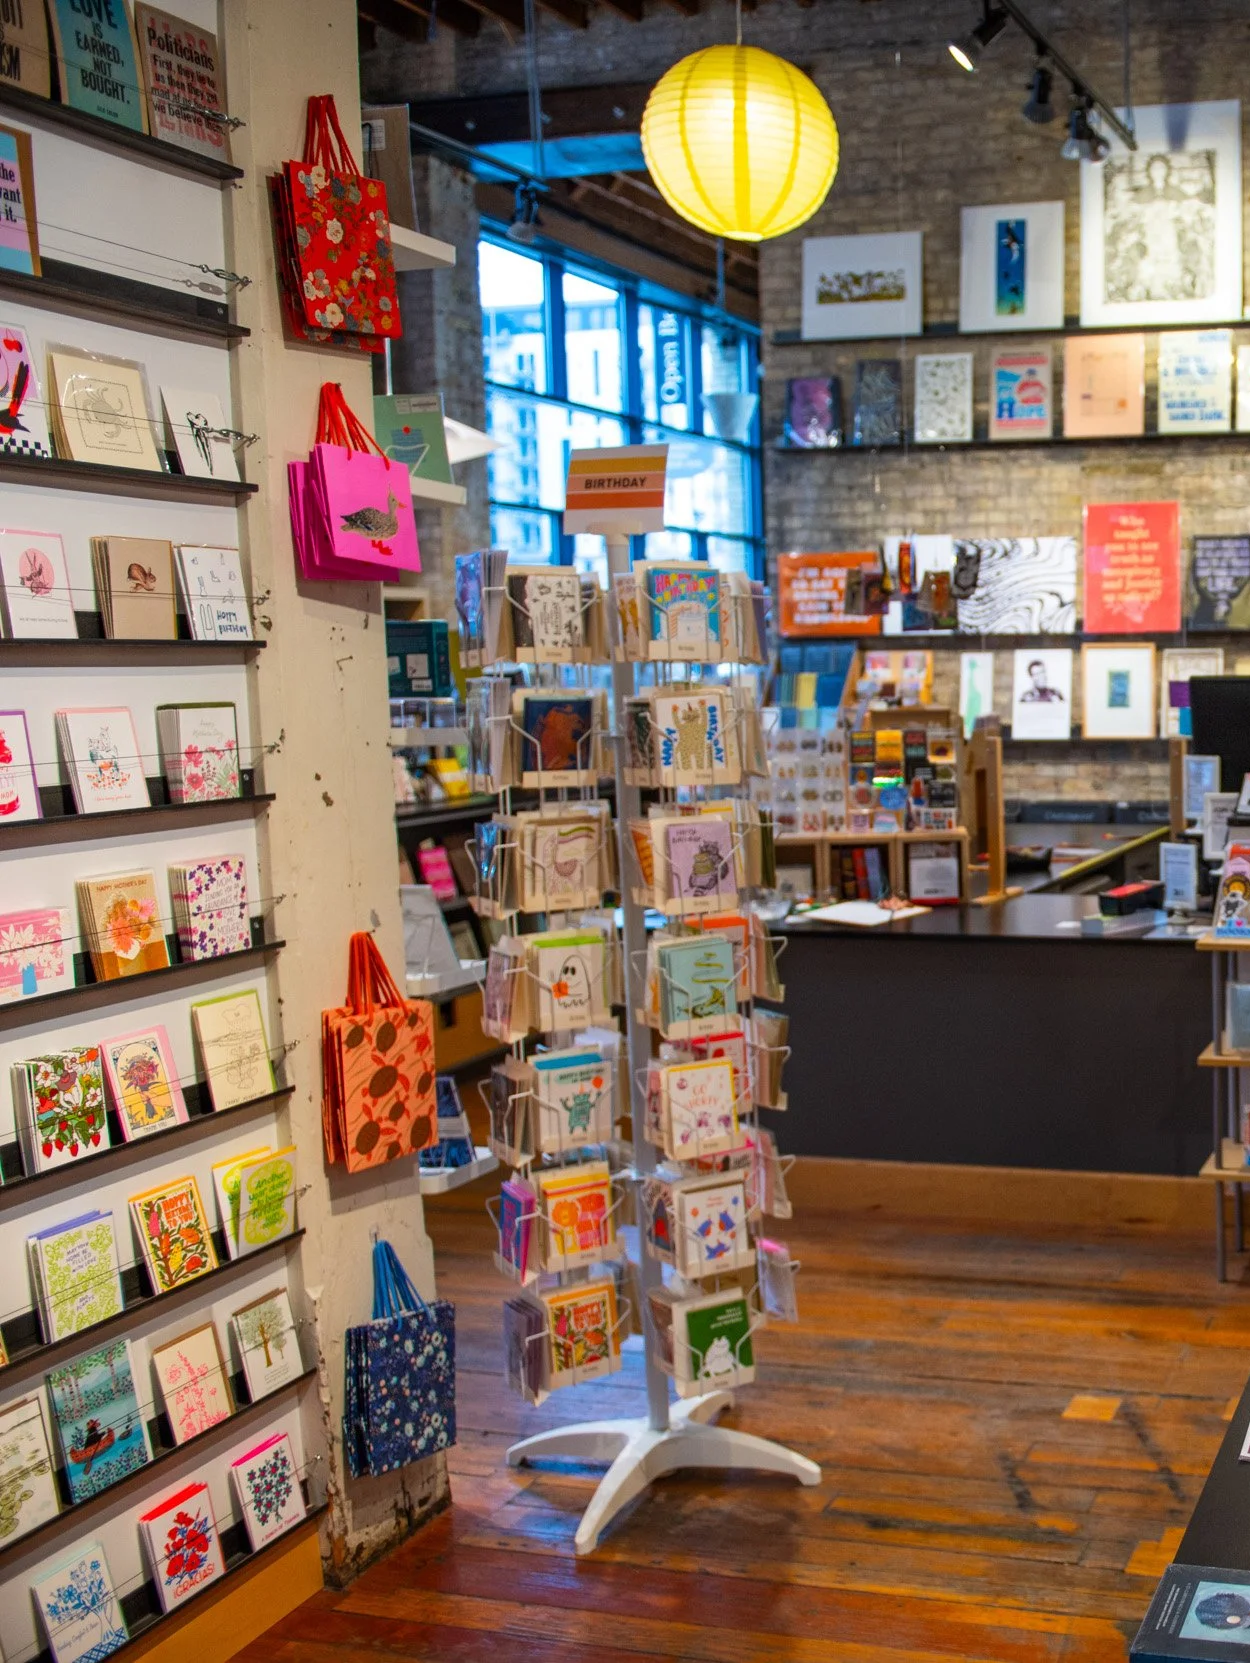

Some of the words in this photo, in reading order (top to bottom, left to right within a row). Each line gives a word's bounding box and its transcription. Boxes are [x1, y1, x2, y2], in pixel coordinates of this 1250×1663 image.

[92, 21, 104, 39] IS
[75, 30, 125, 67] EARNED,
[147, 27, 214, 71] Politicians
[93, 57, 112, 77] NOT
[153, 54, 175, 73] First,
[177, 62, 194, 80] they
[80, 68, 130, 104] BOUGHT.
[151, 86, 170, 100] mad
[154, 72, 166, 83] us
[167, 74, 185, 90] then
[187, 83, 204, 101] they
[153, 102, 167, 114] we
[168, 104, 203, 126] believe
[0, 163, 15, 182] he
[5, 205, 17, 222] it.
[661, 340, 685, 404] Open
[584, 476, 647, 489] BIRTHDAY
[655, 573, 692, 593] HAPPY
[664, 576, 715, 601] BIRTHDAY
[173, 1562, 215, 1599] ¡GRACIAS!
